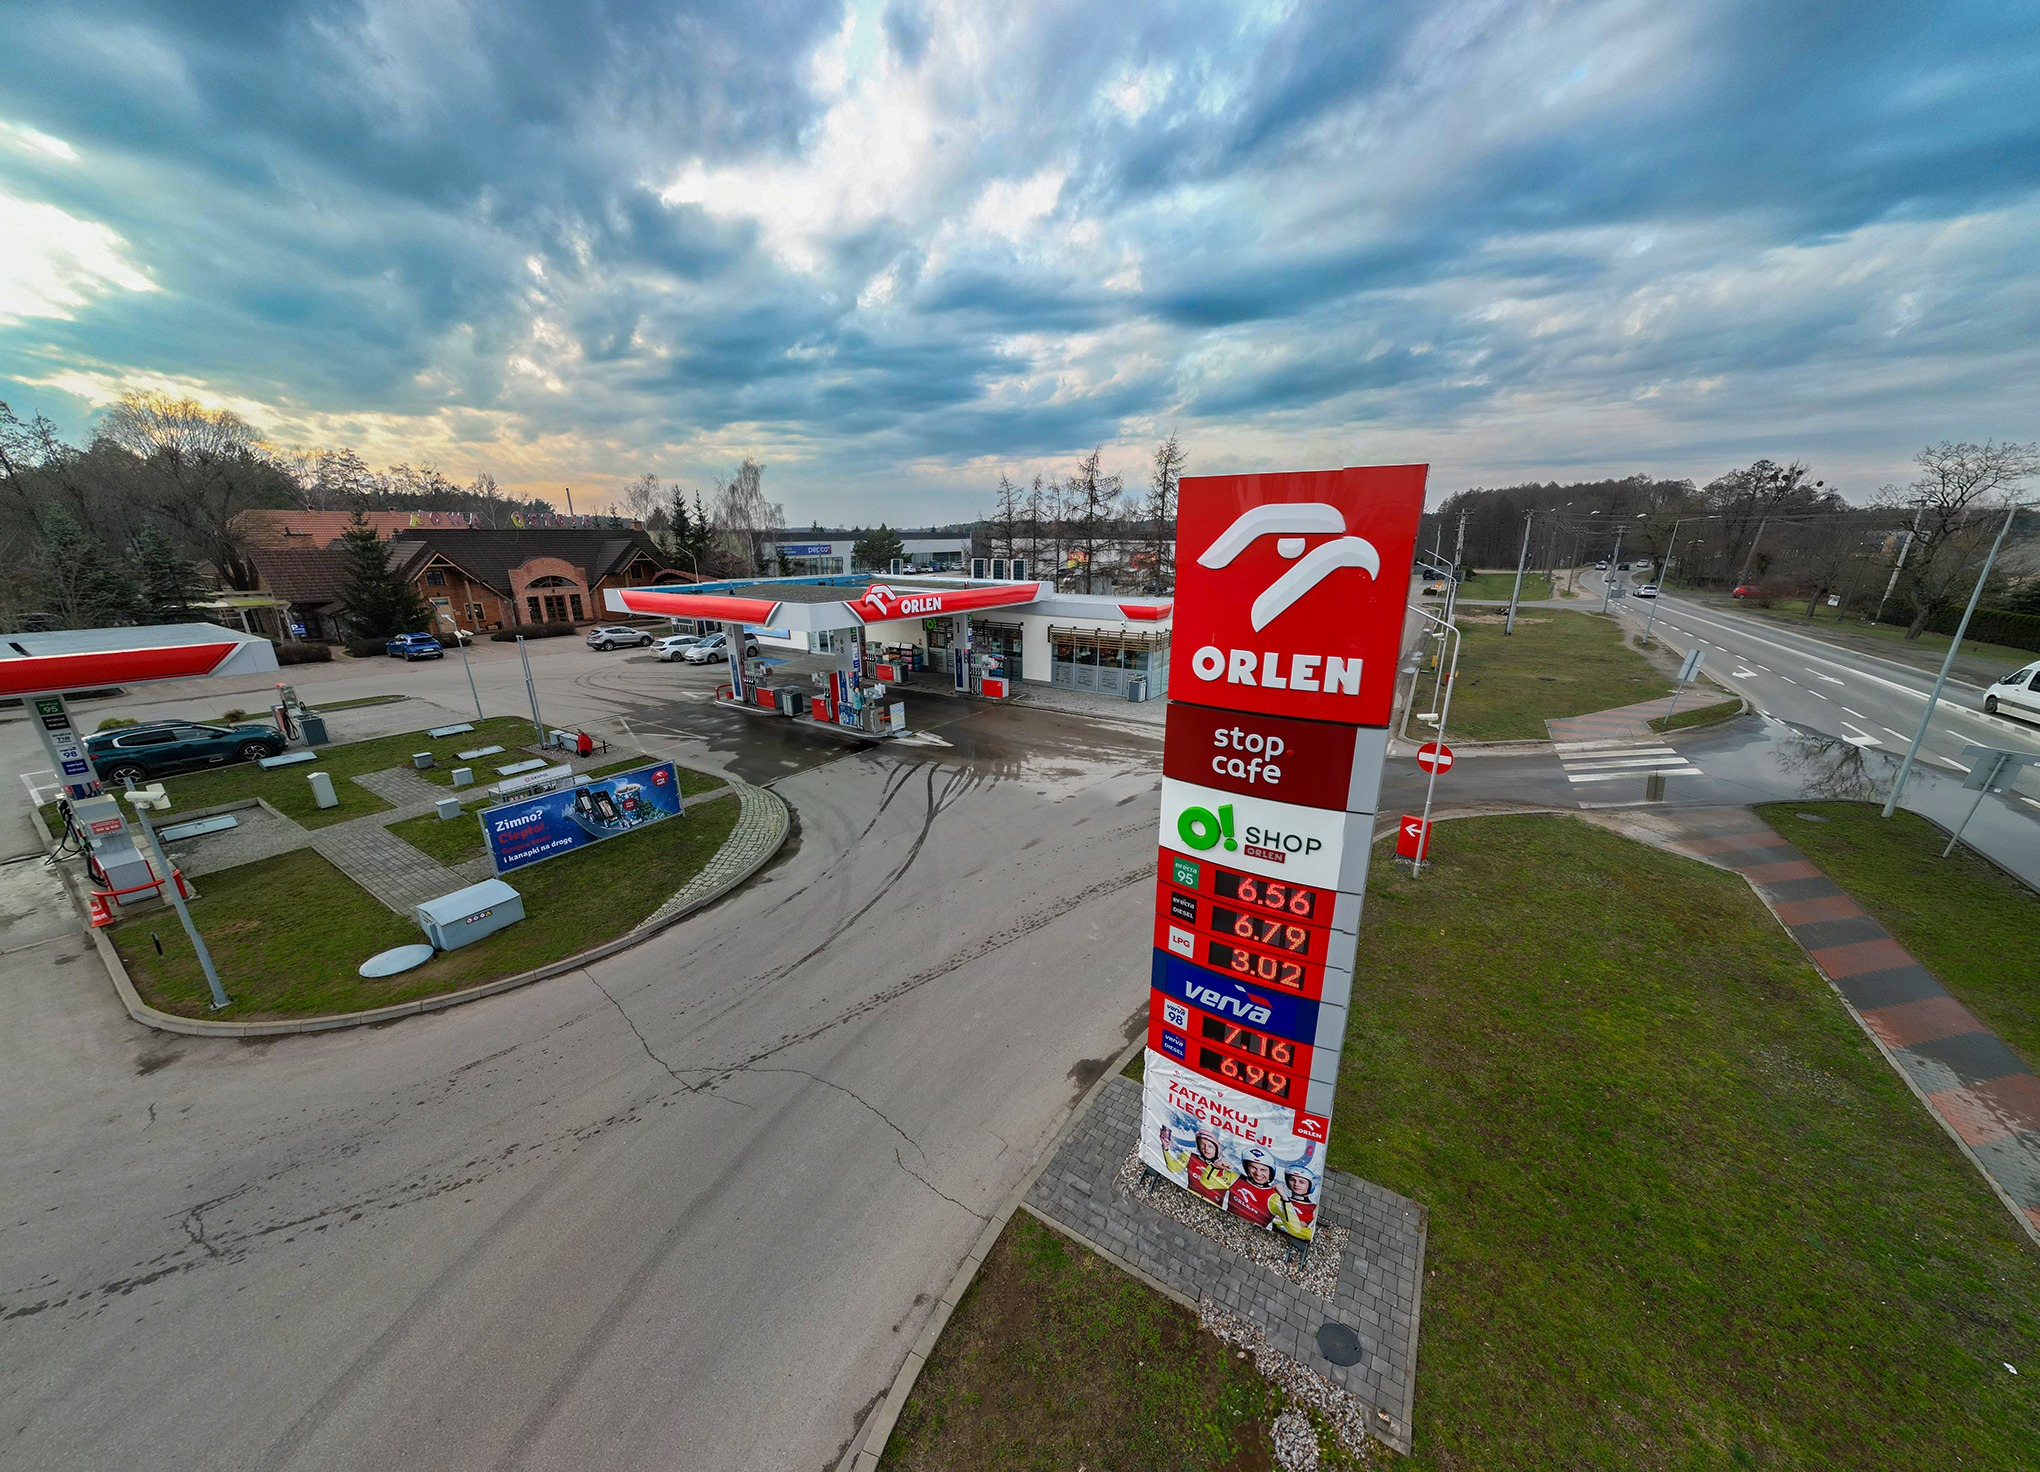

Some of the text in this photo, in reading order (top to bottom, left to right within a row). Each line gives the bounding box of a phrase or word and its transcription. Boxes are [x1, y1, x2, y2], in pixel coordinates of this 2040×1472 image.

[808, 546, 829, 554] pepco
[901, 597, 942, 614] ORLEN
[728, 626, 733, 638] 4
[1192, 645, 1363, 696] ORLEN
[1214, 727, 1284, 761] stop
[1212, 754, 1281, 784] cafe
[495, 810, 543, 832] Zimno?
[498, 821, 545, 844] Ciepło!
[1177, 803, 1322, 855] O! SHOP
[509, 846, 540, 862] kanapki
[551, 836, 573, 848] drogę
[1247, 847, 1283, 862] ORLEN
[1177, 870, 1310, 916] 95 6.56
[1172, 906, 1306, 951] DIESEL 6.79
[1173, 935, 1301, 989] LPG 3.02
[1166, 1003, 1186, 1016] verva
[1185, 980, 1272, 1025] verva
[1165, 1034, 1184, 1047] verva
[1168, 1011, 1291, 1064] 98 7.16
[1164, 1042, 1184, 1056] DIESEL
[1220, 1057, 1287, 1094] 6.99
[1169, 1080, 1259, 1128] ZATANKUJ
[1168, 1093, 1273, 1148] I LEĆ DALEJ!
[1297, 1128, 1322, 1139] ORLEN
